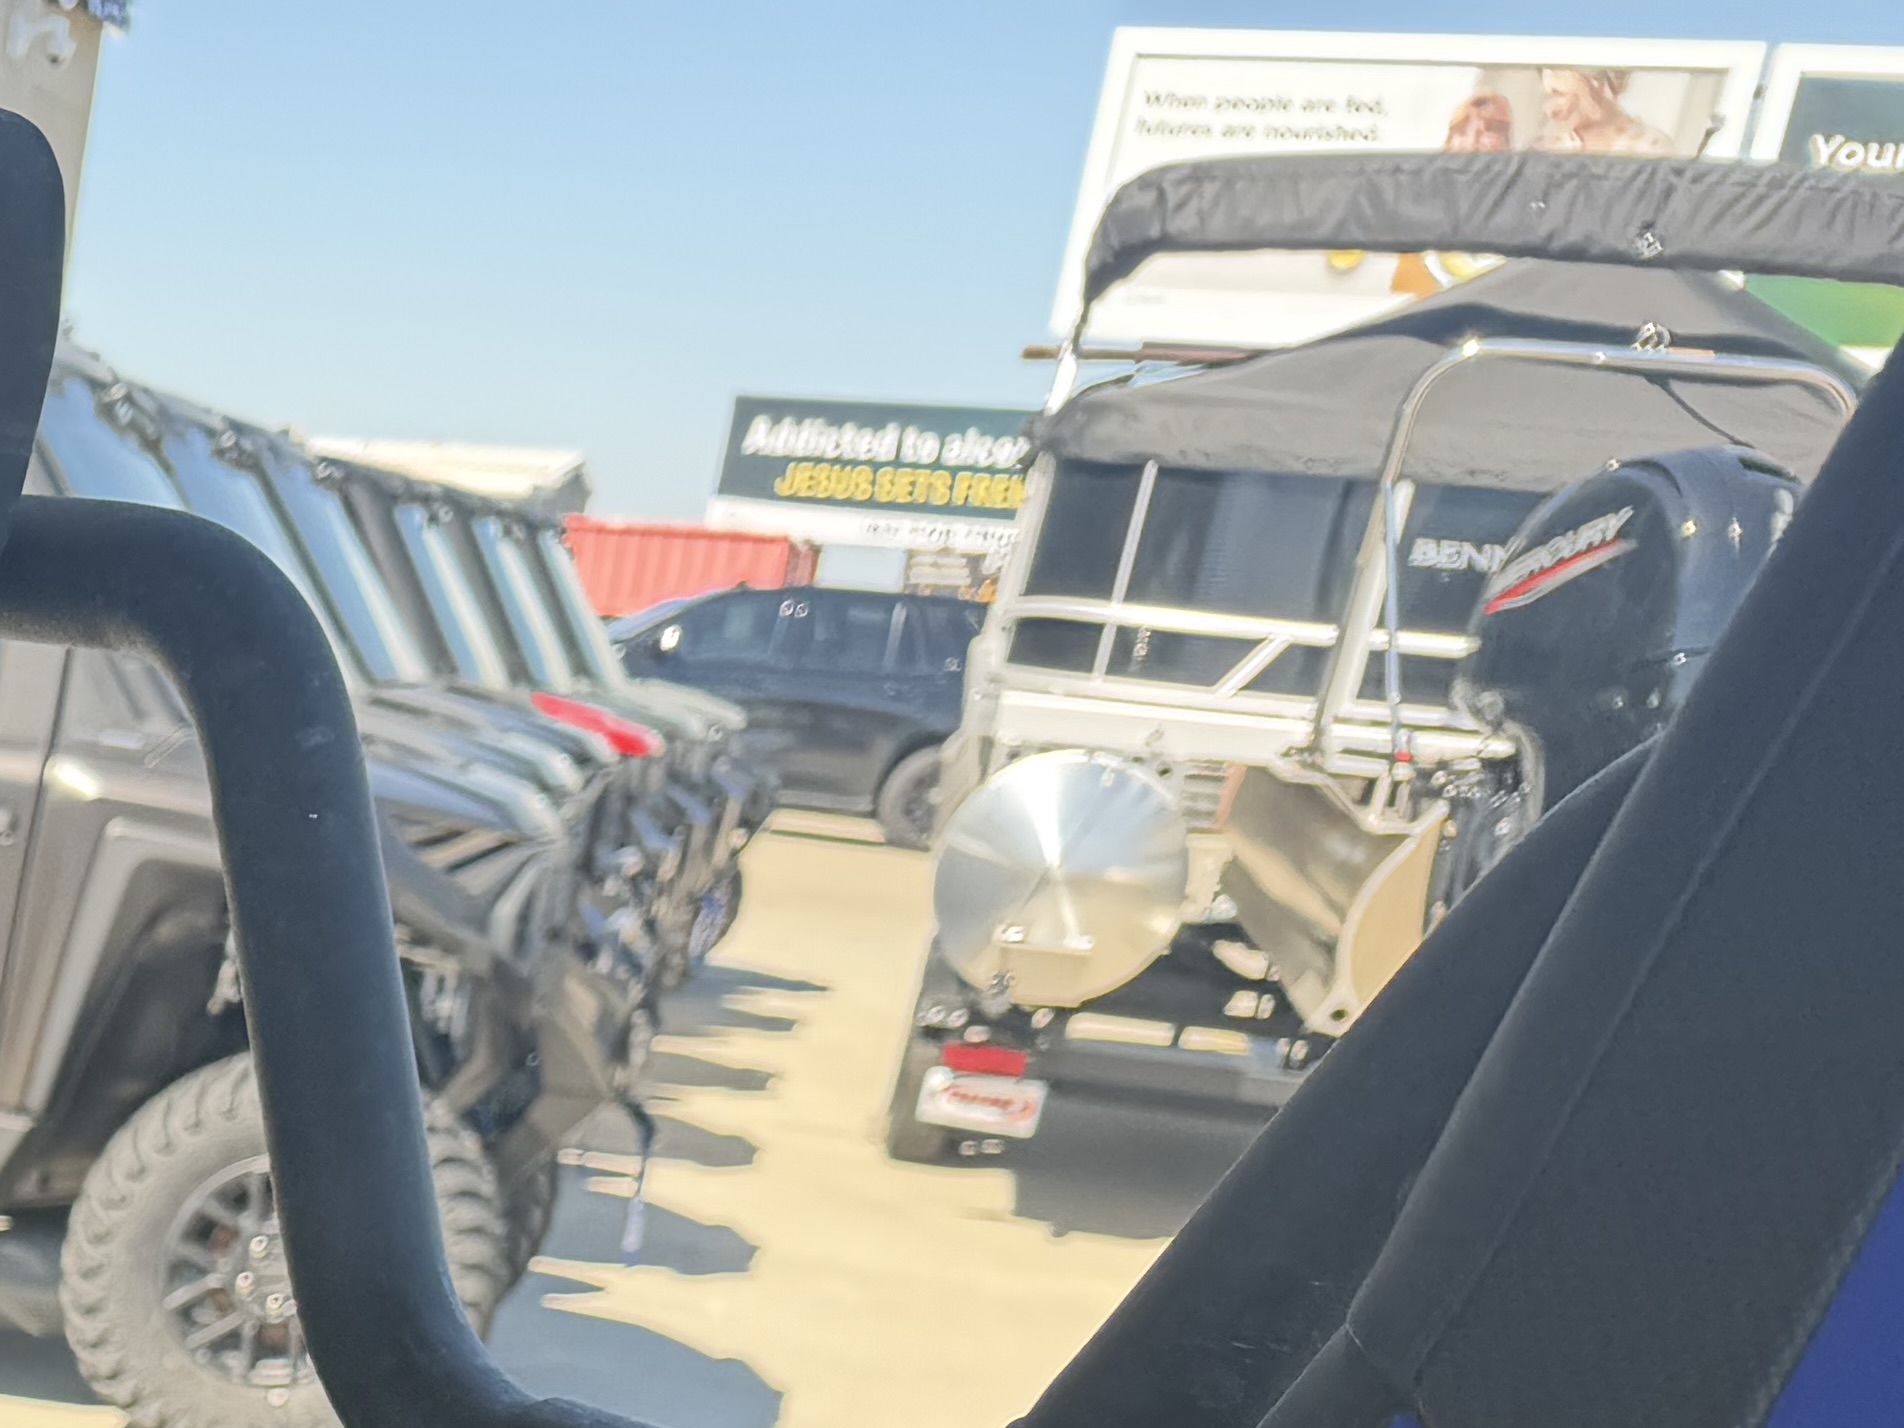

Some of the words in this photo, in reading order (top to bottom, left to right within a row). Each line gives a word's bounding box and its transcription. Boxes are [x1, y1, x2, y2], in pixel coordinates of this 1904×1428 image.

[742, 415, 901, 461] Addicted
[901, 425, 940, 463] to
[774, 462, 873, 500] JESUS
[874, 467, 952, 505] SETS
